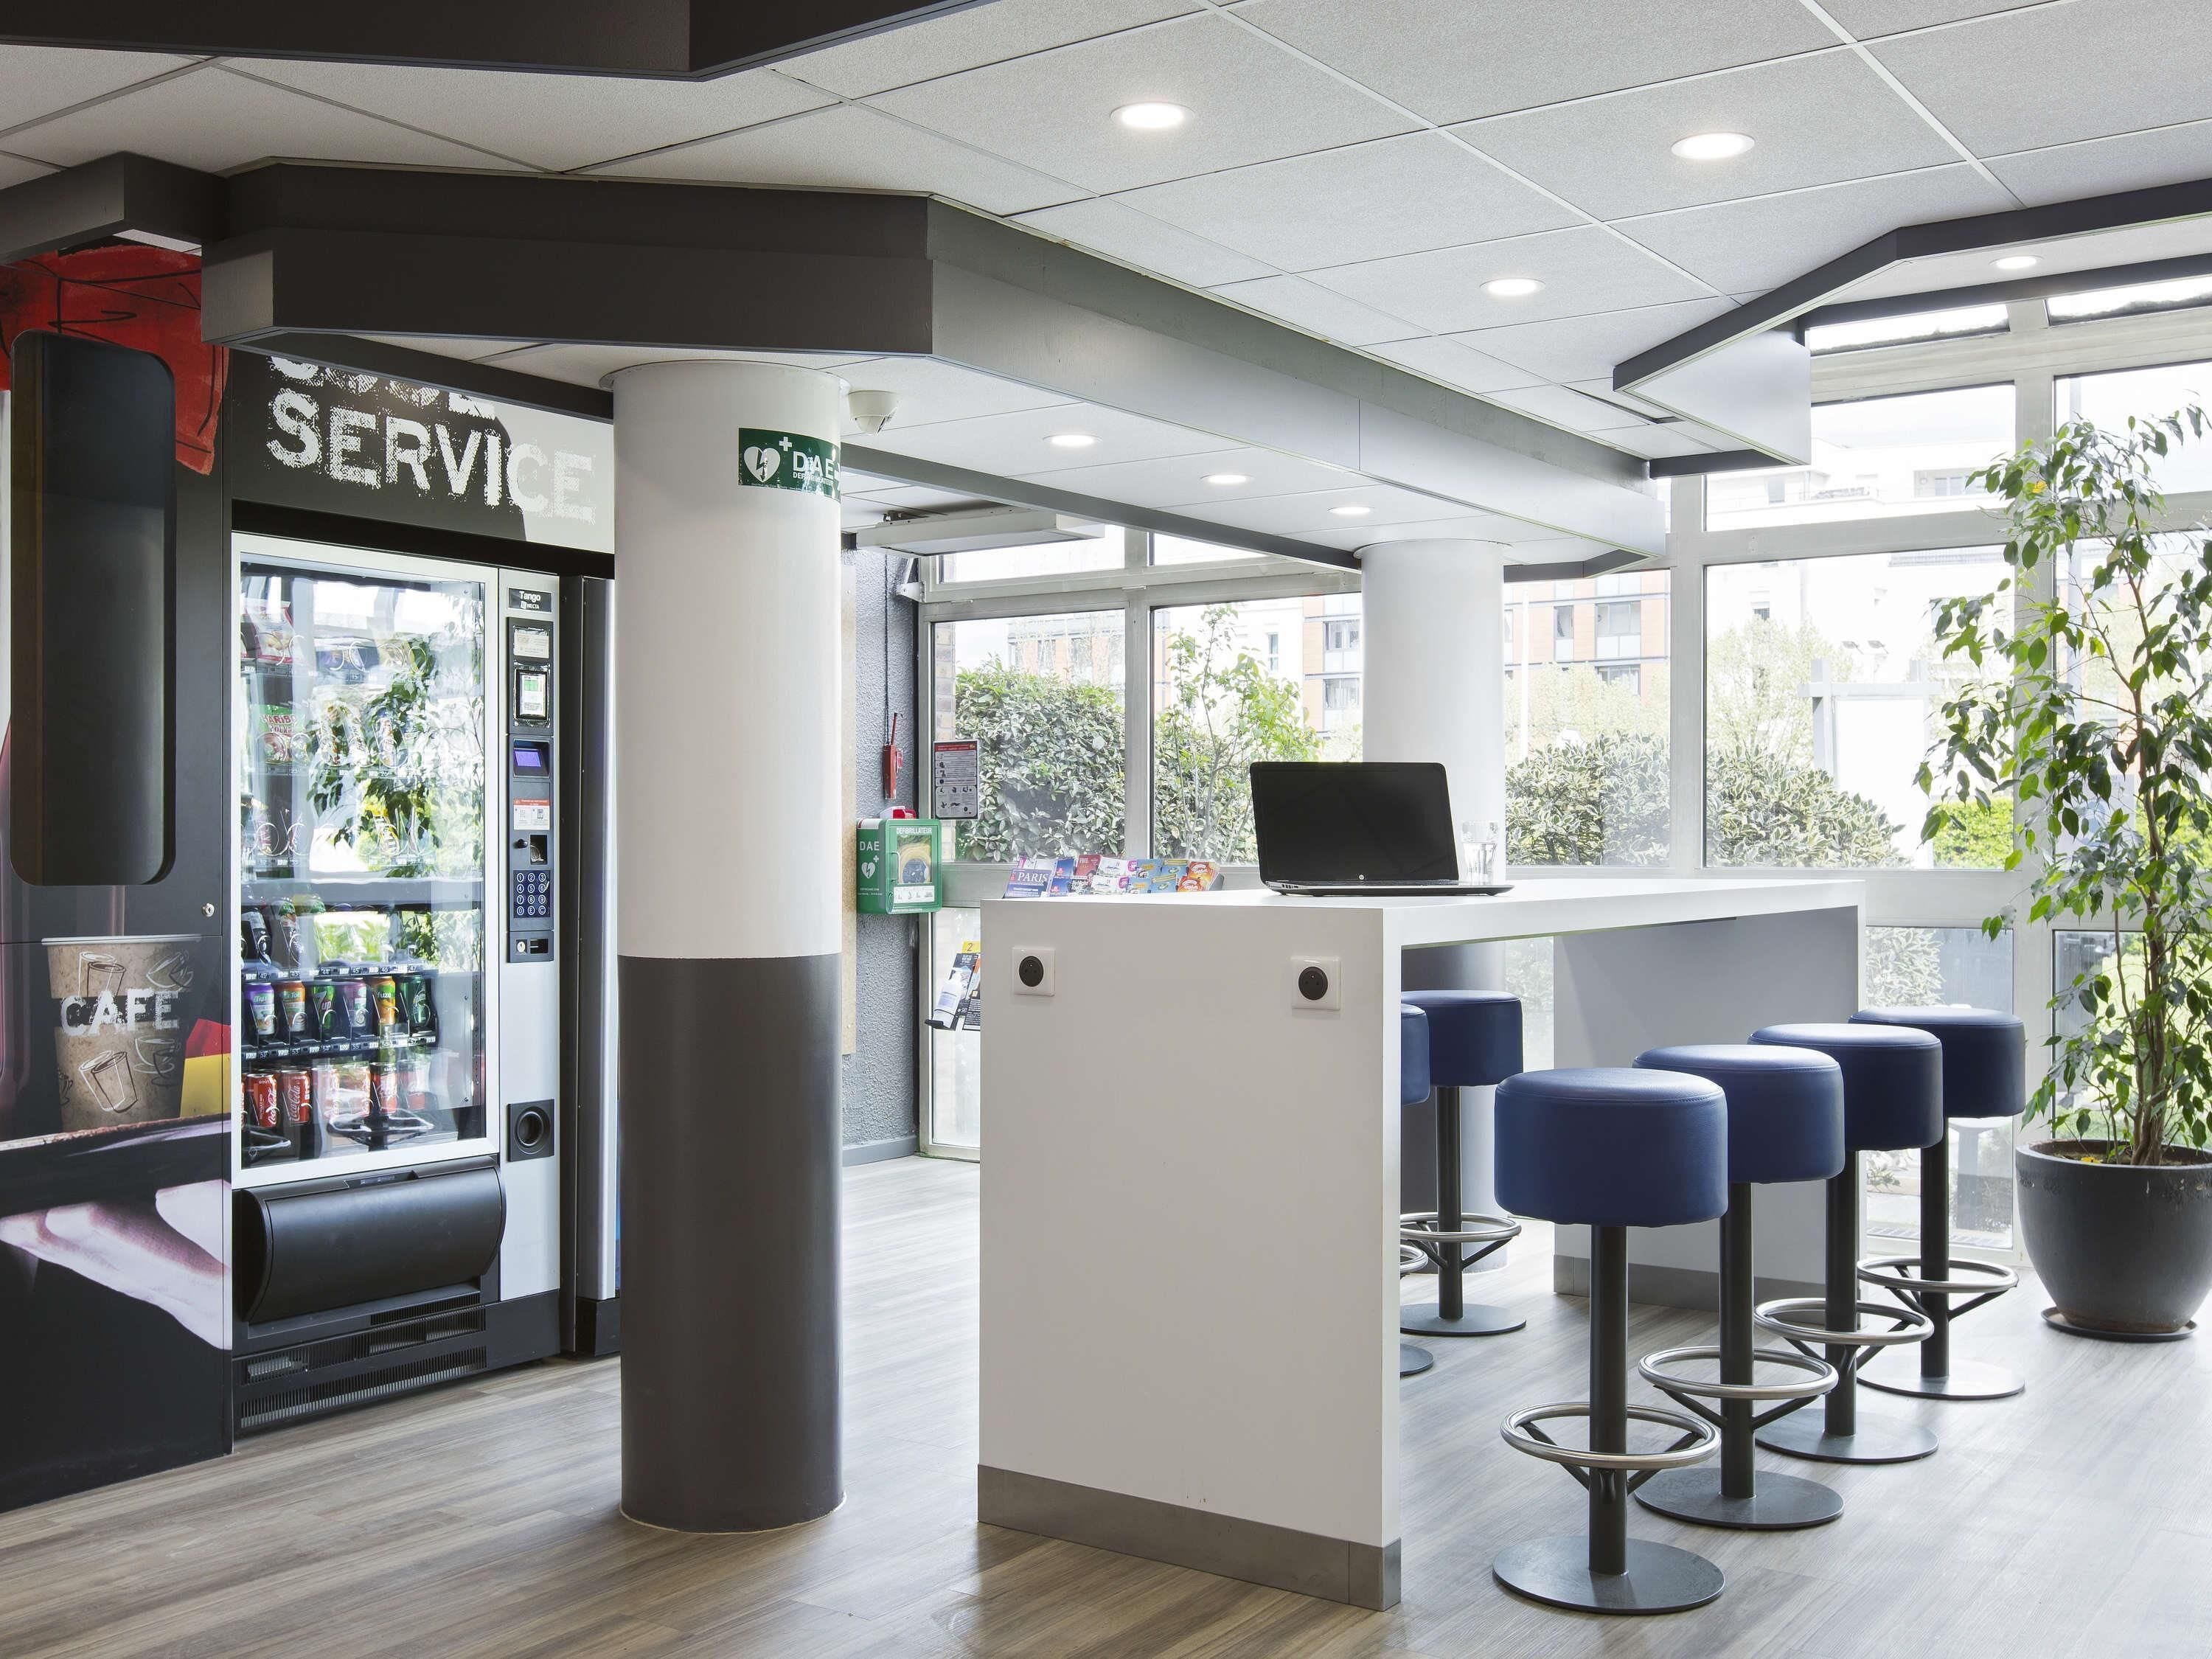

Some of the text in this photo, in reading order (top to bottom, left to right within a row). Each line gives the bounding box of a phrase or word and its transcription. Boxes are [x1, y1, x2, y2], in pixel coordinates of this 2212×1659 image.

[266, 387, 597, 524] SERVICE
[519, 591, 541, 602] Tango
[860, 841, 880, 851] DAE
[1018, 872, 1048, 882] PARIS
[967, 943, 973, 951] 2
[60, 988, 178, 1036] CAFE
